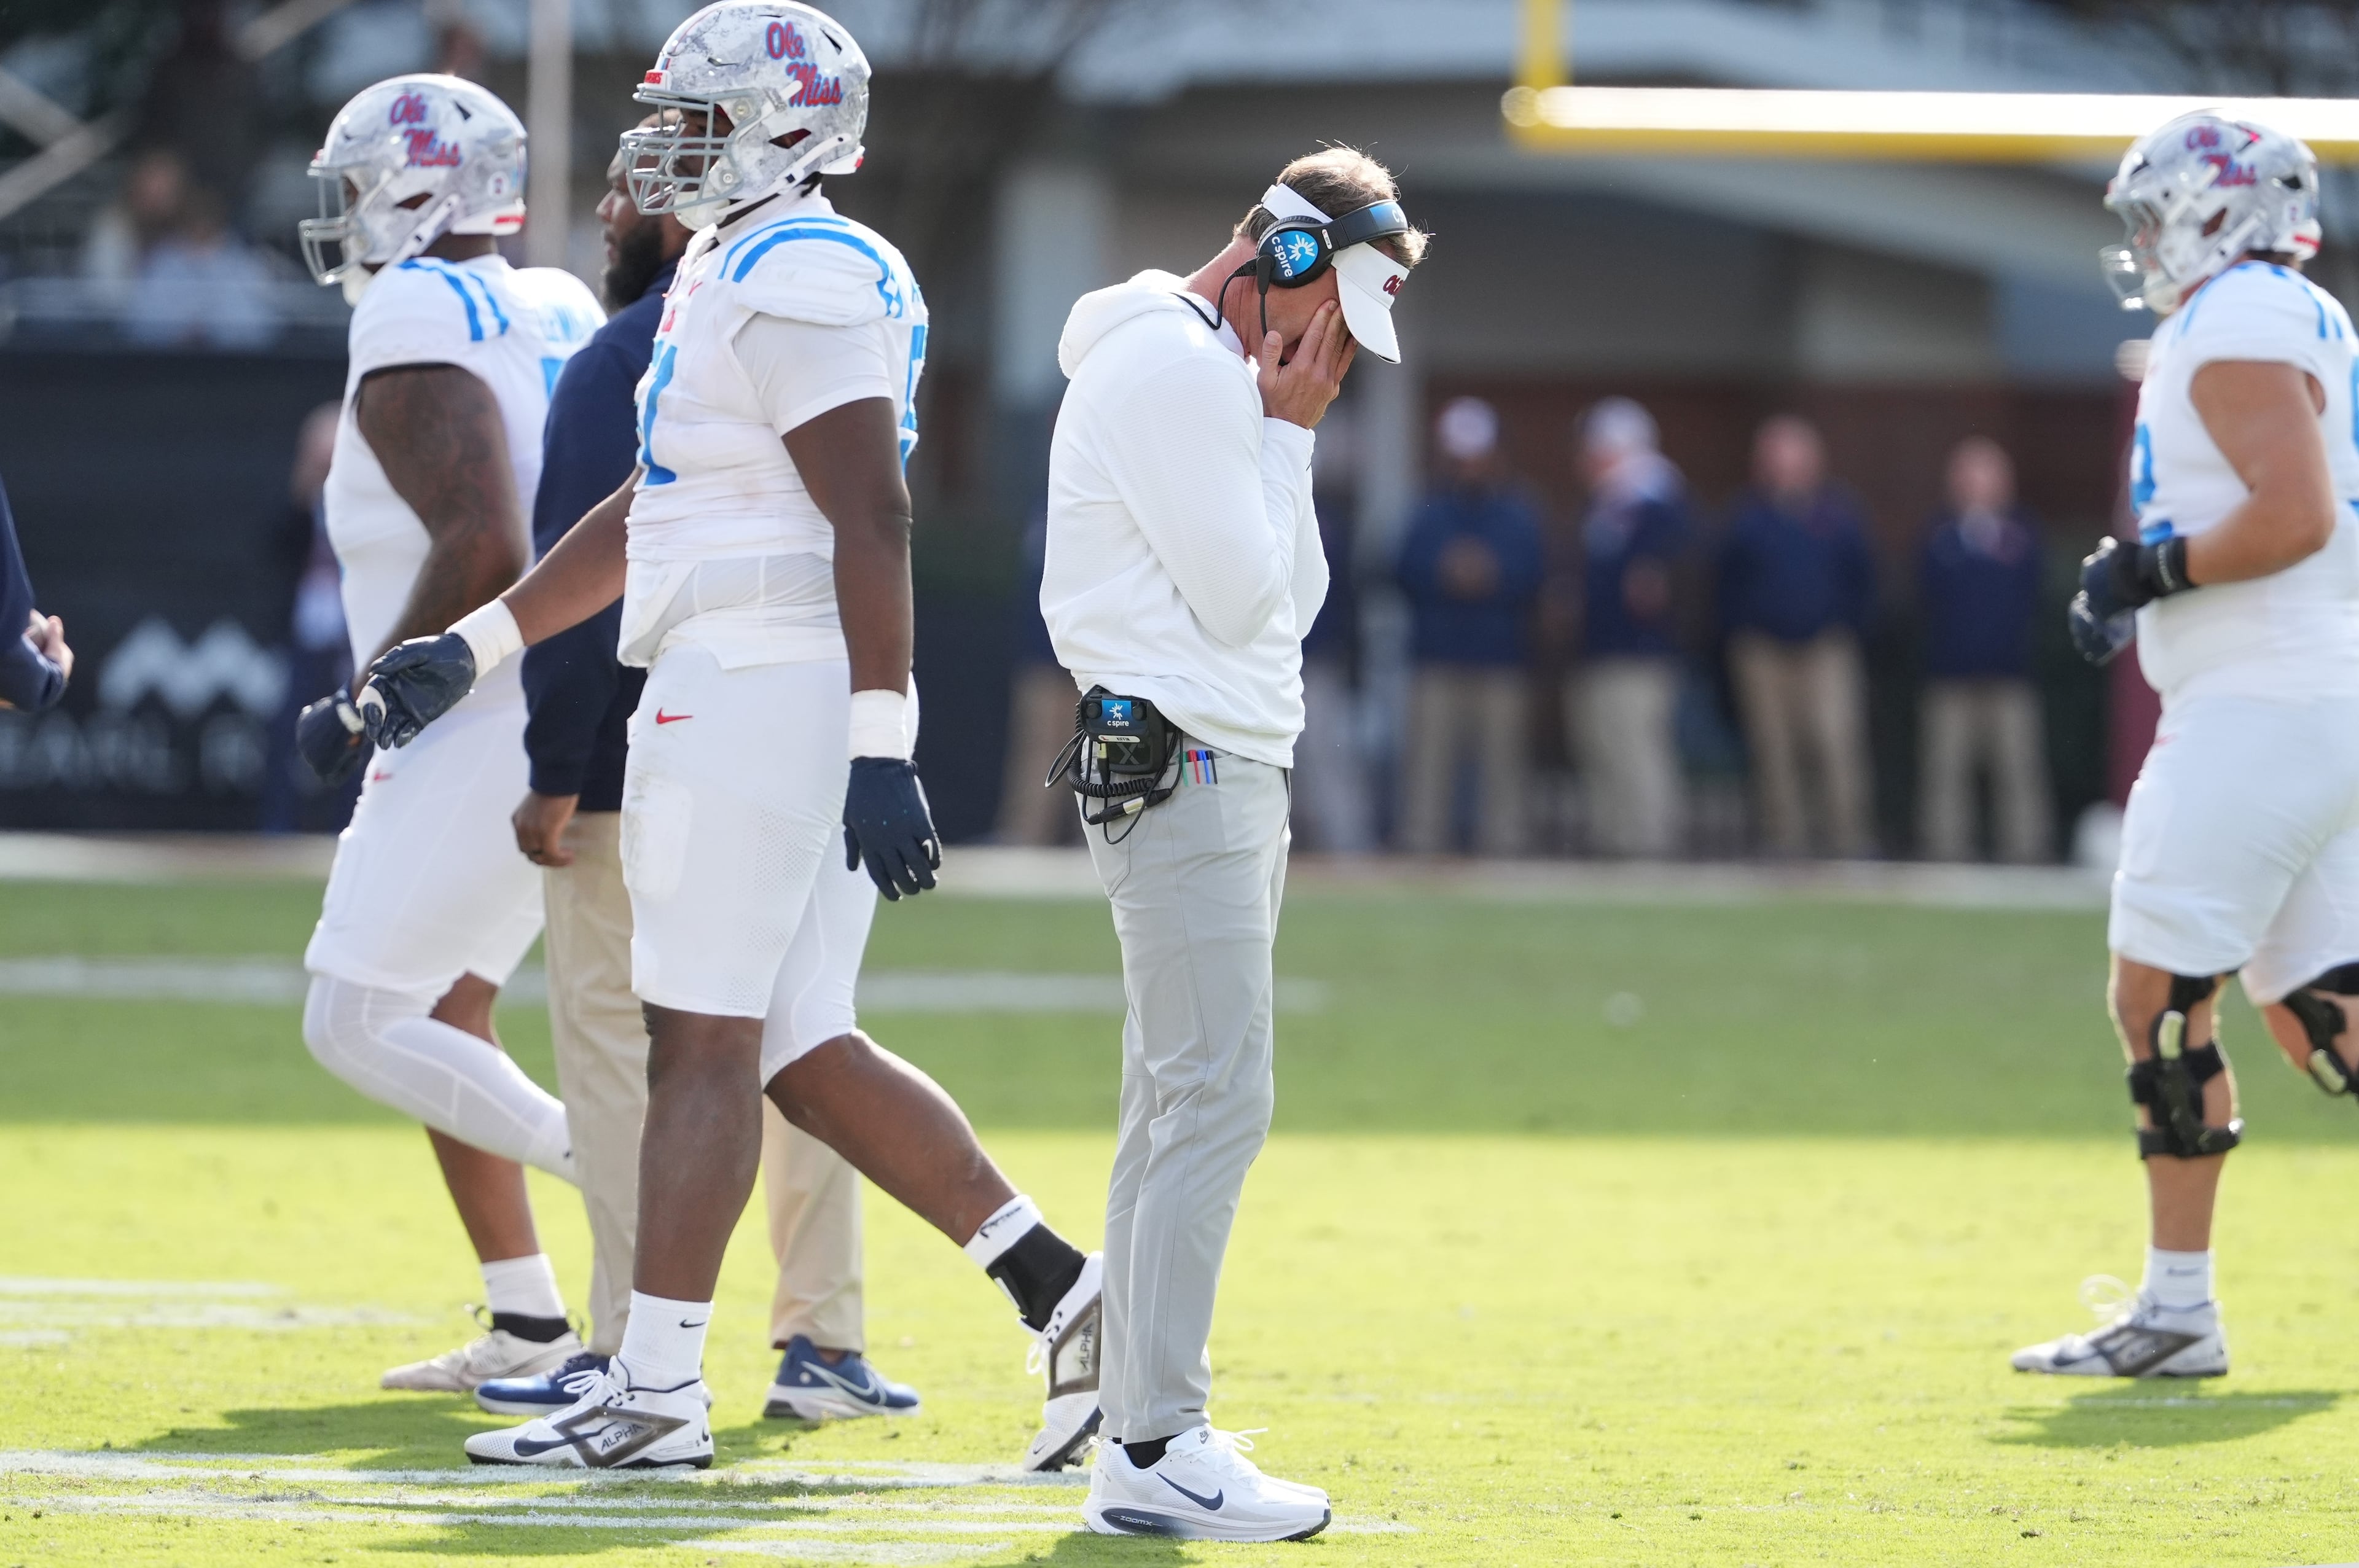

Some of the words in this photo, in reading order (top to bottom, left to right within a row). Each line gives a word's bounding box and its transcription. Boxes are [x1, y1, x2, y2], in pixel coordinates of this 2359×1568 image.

[765, 21, 806, 60] Ole
[786, 61, 844, 109] Miss
[389, 92, 428, 125] Ole
[402, 127, 463, 167] Miss
[2185, 125, 2222, 151] Ole
[601, 1422, 645, 1452] ALPHA
